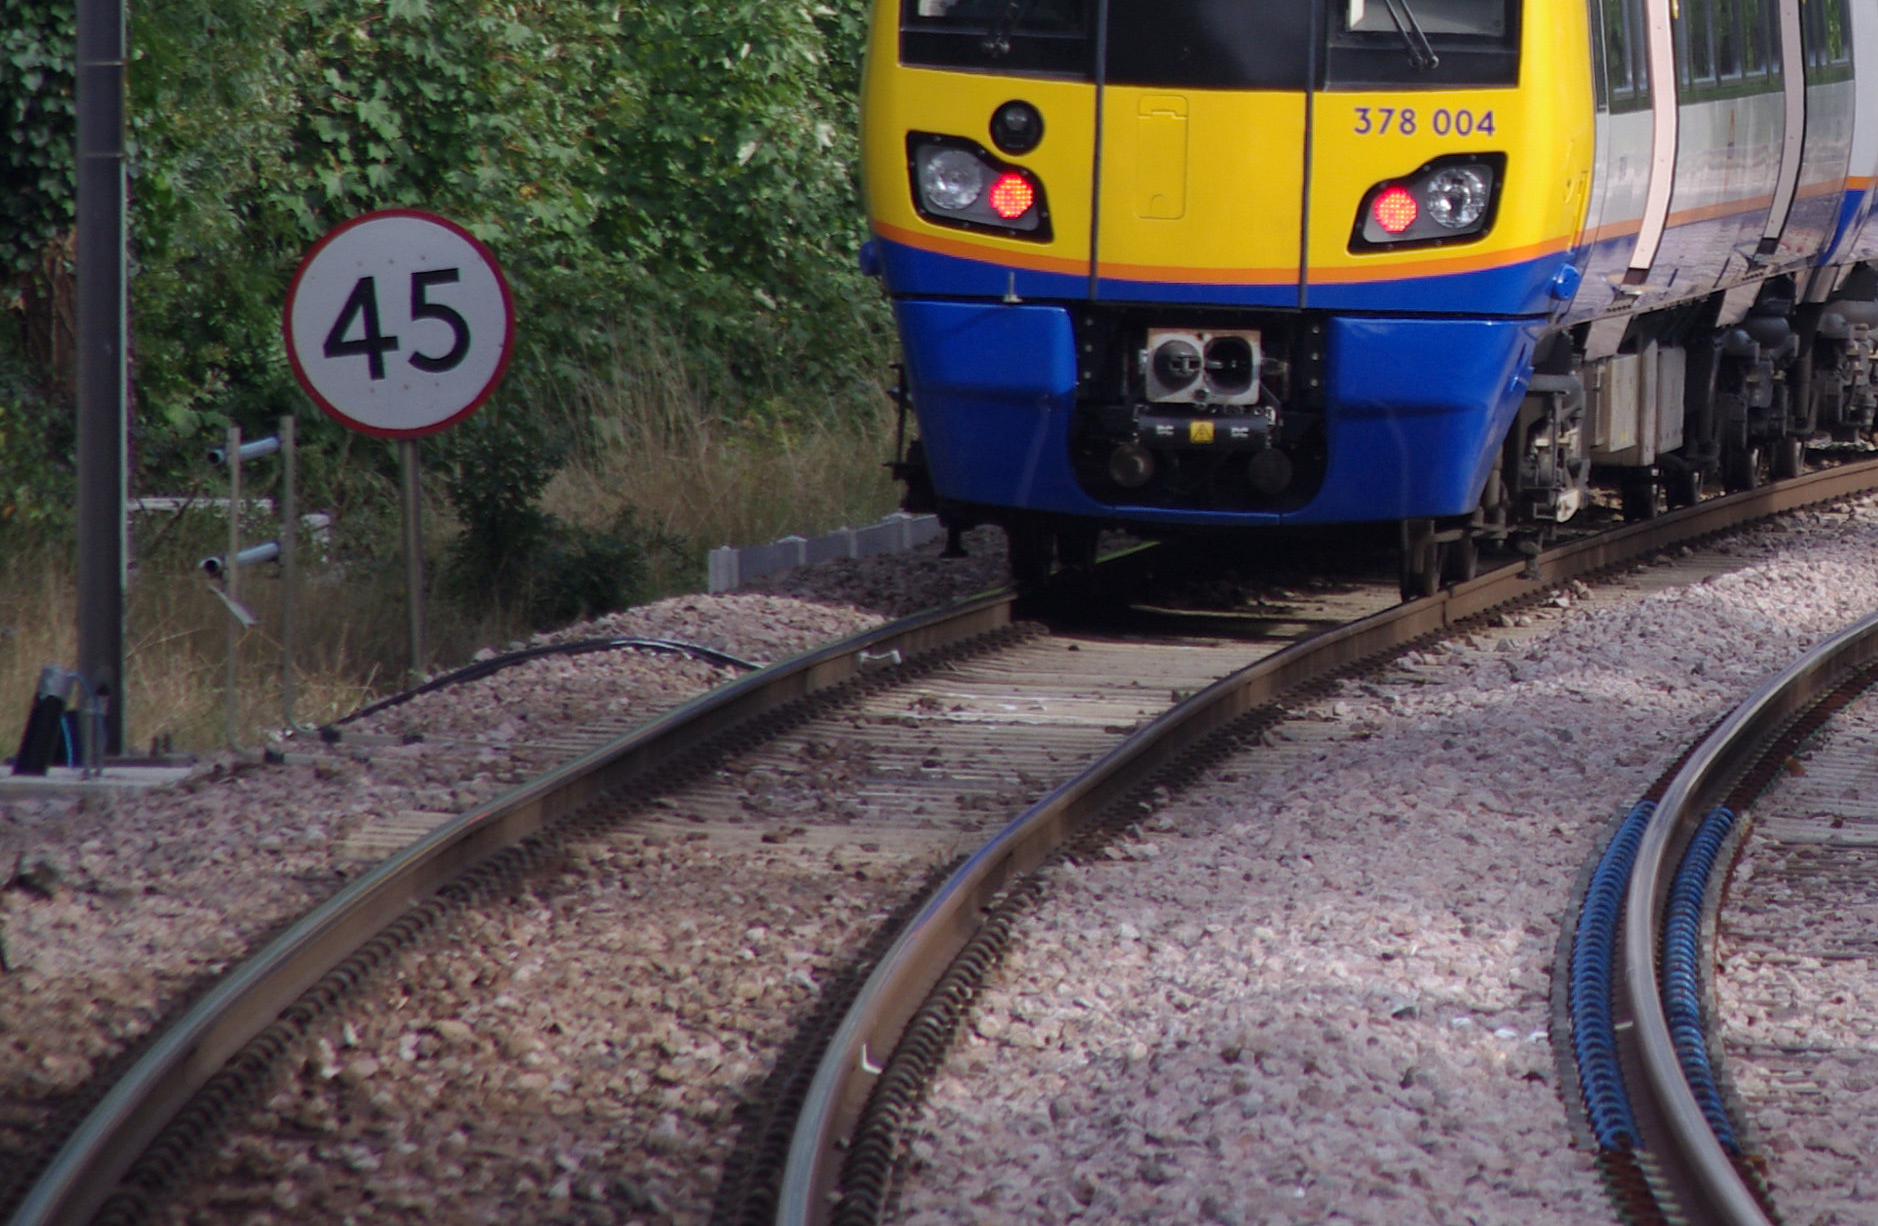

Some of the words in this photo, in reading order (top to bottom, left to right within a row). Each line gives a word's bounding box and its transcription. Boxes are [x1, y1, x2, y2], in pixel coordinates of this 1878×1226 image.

[1354, 107, 1417, 136] 378
[1432, 108, 1496, 136] 004
[323, 267, 471, 381] 45
